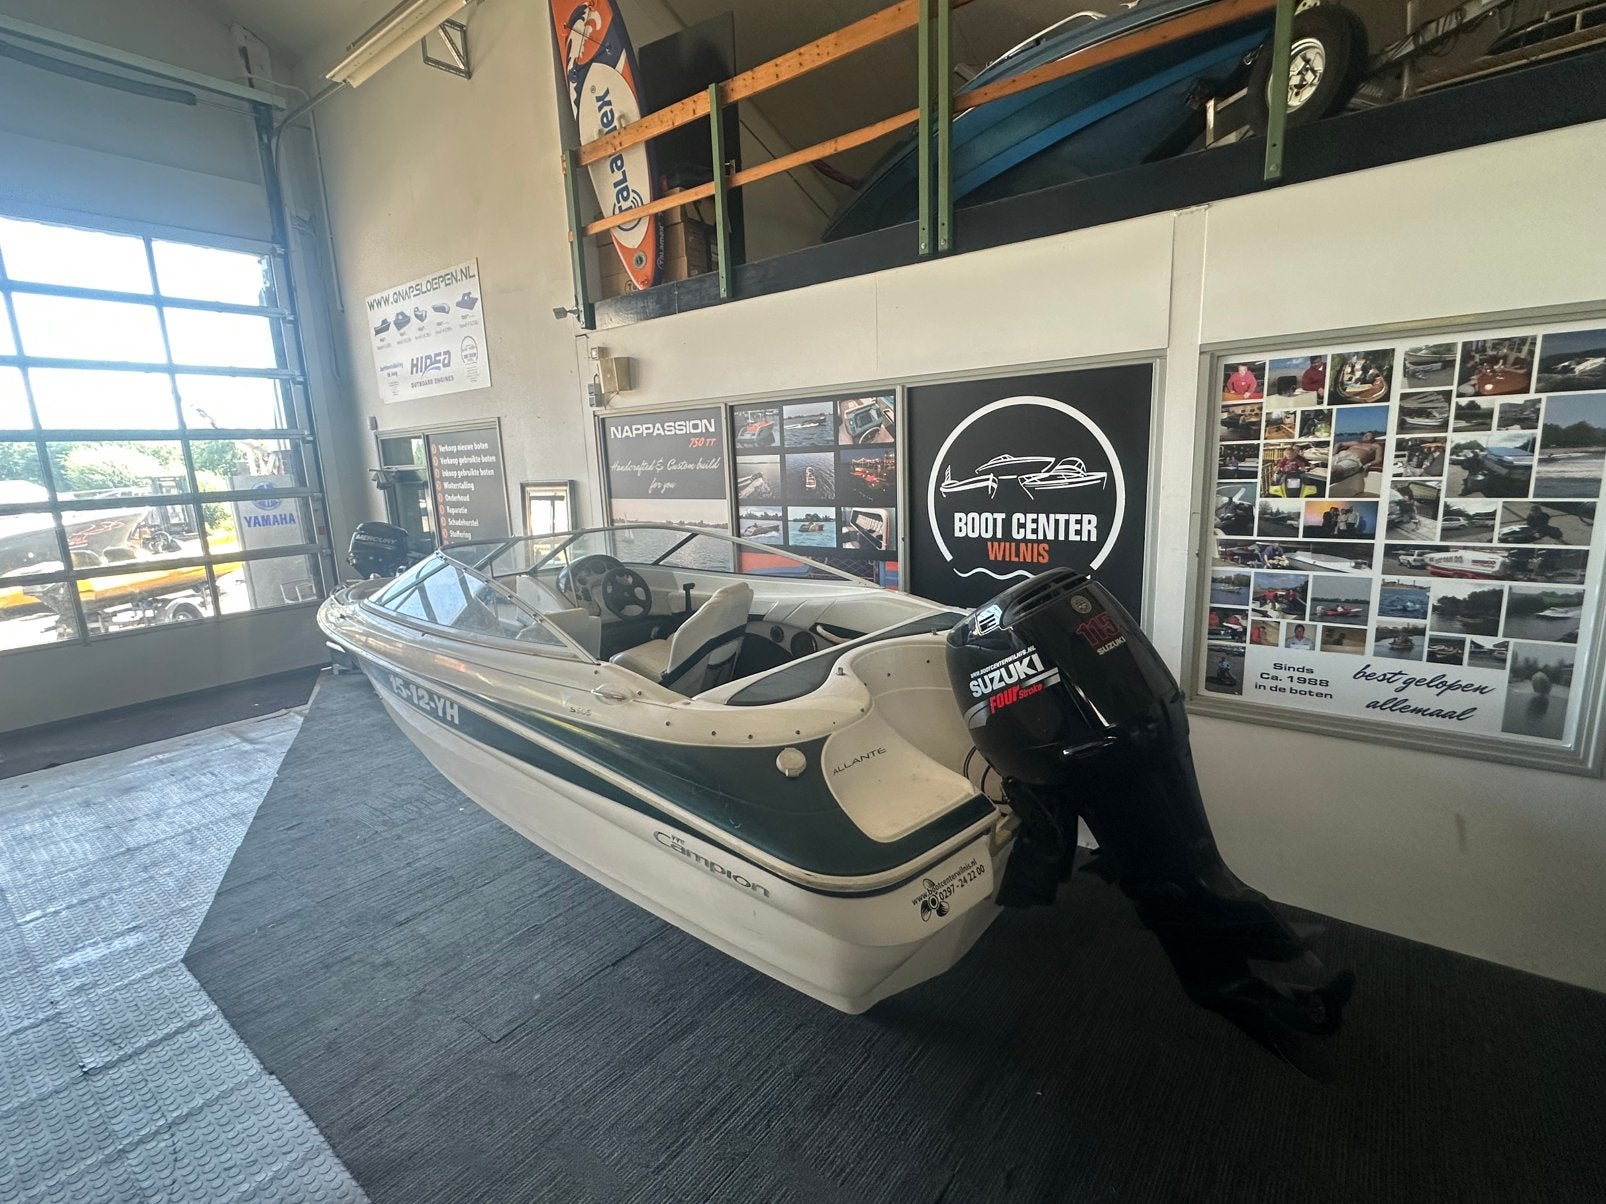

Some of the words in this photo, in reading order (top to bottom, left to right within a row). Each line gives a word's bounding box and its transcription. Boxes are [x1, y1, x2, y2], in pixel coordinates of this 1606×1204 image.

[610, 419, 715, 439] NAPPASSION
[473, 441, 489, 450] boten
[459, 455, 480, 466] gebruikte
[481, 454, 496, 463] boten
[457, 468, 480, 479] gebruikte
[479, 468, 495, 476] boten
[243, 513, 296, 528] YAMAHA
[954, 512, 1006, 538] BOOT
[1012, 513, 1098, 542] CENTER
[987, 541, 1050, 563] WILNIS
[1075, 611, 1119, 646] 115
[1096, 635, 1126, 655] SUZUKI
[969, 653, 1044, 697] SUZUKI
[1273, 662, 1314, 674] Sinds
[1254, 682, 1267, 691] in
[1269, 685, 1287, 693] de
[1289, 687, 1333, 699] boten
[1260, 672, 1283, 682] Ca.
[1286, 675, 1330, 687] 1988
[1353, 664, 1408, 684] best
[1394, 674, 1496, 697] gelopen
[388, 674, 459, 725] 15-12-YH
[1365, 697, 1477, 721] allemaal
[832, 747, 887, 776] ALLANTE
[653, 831, 770, 898] Campion
[939, 884, 955, 901] 0297
[958, 876, 968, 888] 24
[967, 869, 977, 881] 22
[976, 864, 985, 875] 00
